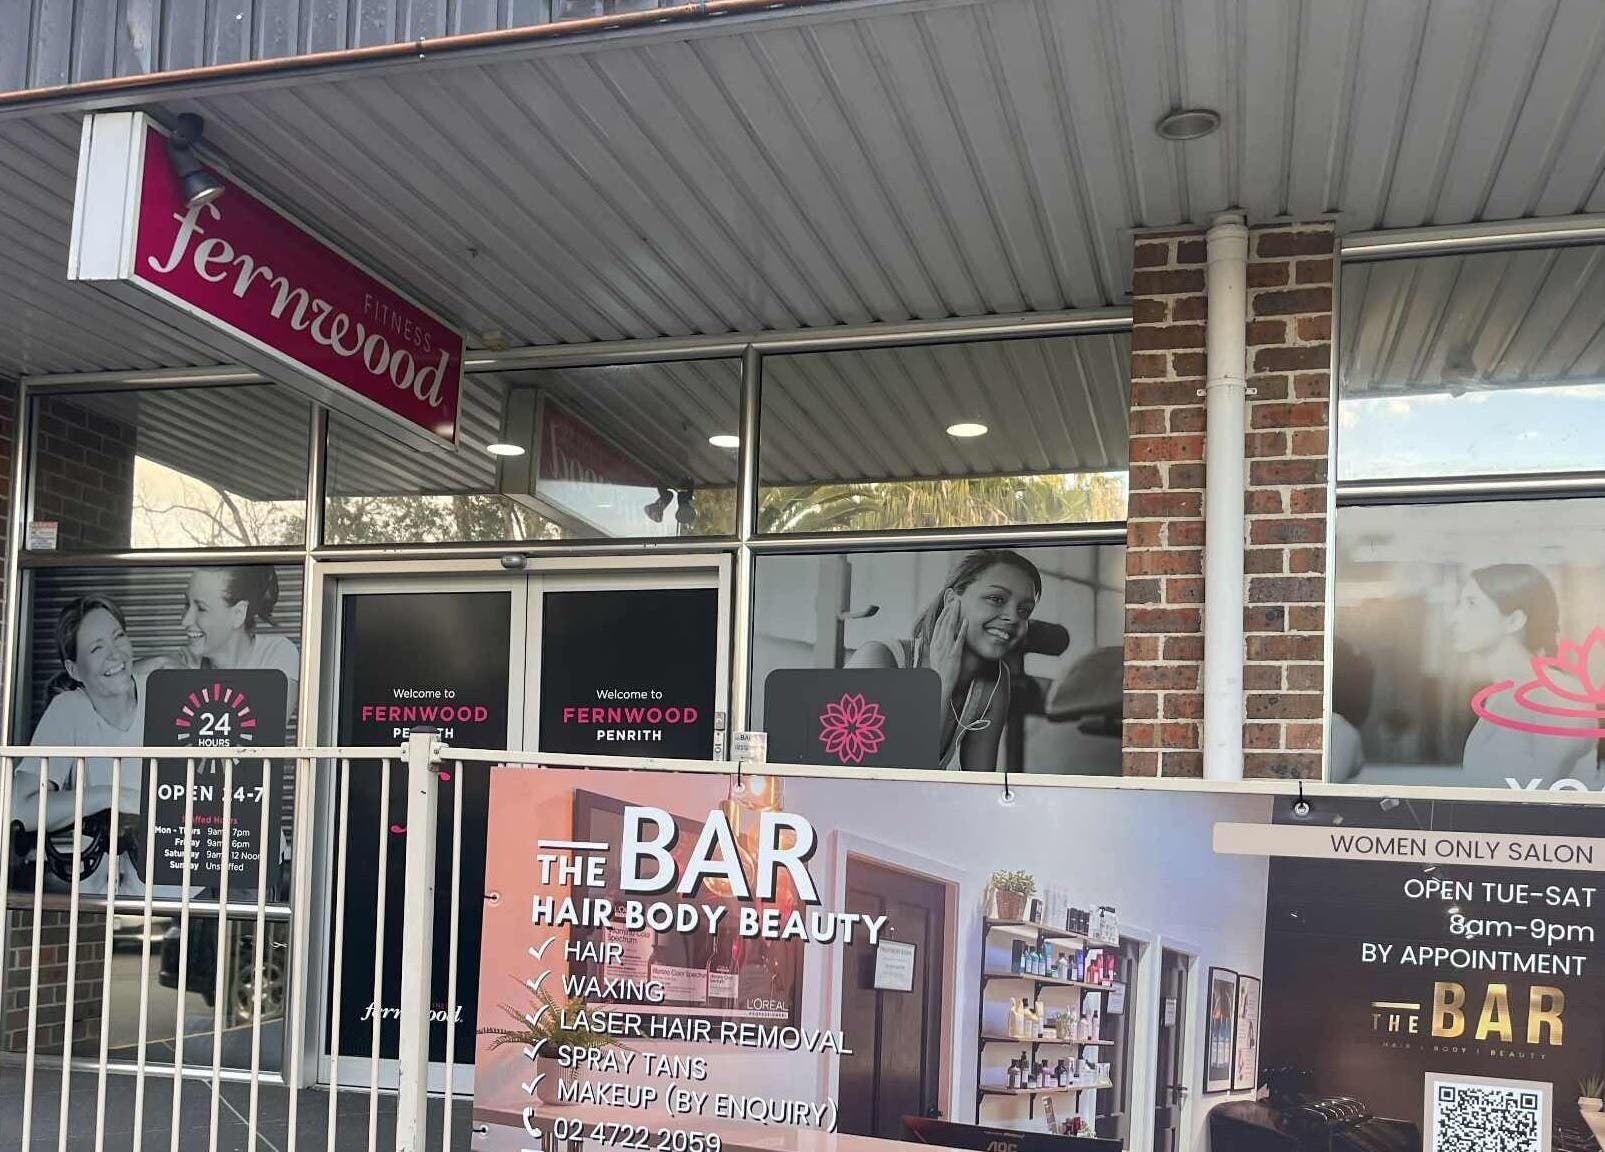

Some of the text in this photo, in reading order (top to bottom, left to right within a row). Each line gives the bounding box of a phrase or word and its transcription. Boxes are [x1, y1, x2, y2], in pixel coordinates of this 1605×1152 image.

[148, 201, 448, 407] fernwood
[364, 293, 432, 353] FITNESS
[393, 688, 455, 699] Welcome to
[596, 688, 663, 700] Welcome to
[199, 712, 231, 736] 24
[362, 705, 488, 722] FERNWOOD
[563, 706, 698, 724] FERNWOOD
[198, 738, 230, 747] HOURS
[393, 727, 454, 739] PETH
[596, 729, 662, 742] PENRITH
[620, 806, 822, 903] BAR
[1331, 834, 1594, 864] WOMEN ONLY SALON
[537, 854, 606, 887] THE
[1404, 878, 1597, 908] OPEN TUE-SAT
[532, 895, 888, 945] HAIR BODY BEAUTY
[1449, 913, 1595, 946] 8am-9pm
[564, 940, 624, 964] HAIR
[1361, 943, 1587, 976] BY APPOINTMENT
[562, 974, 665, 1003] WAXING
[1371, 1013, 1419, 1034] THE
[1431, 981, 1566, 1046] BAR
[560, 1009, 853, 1054] LASER HAIR REMOVAL
[558, 1045, 708, 1081] SPRAY TANS
[557, 1077, 839, 1133] MAKEUP (BY ENQUIRY)
[554, 1117, 722, 1152] 02 4722 2059
